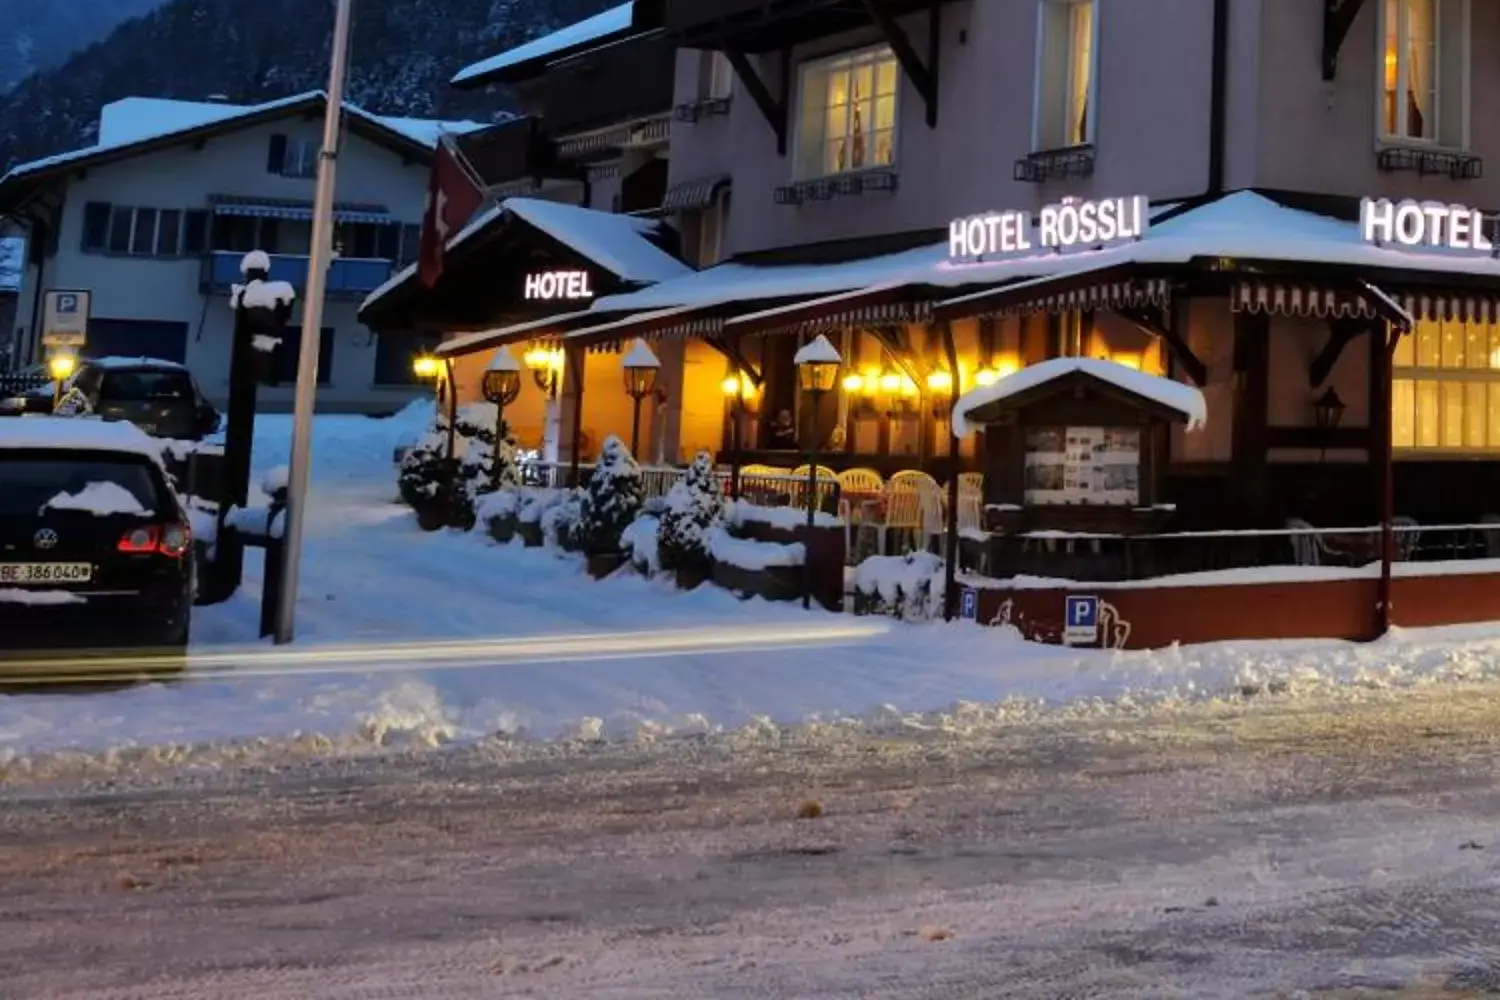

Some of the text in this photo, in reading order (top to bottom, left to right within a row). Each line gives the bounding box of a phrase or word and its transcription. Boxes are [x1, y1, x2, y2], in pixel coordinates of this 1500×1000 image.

[949, 195, 1143, 258] HOTEL RÖSSLI
[1365, 200, 1493, 251] HOTEL
[524, 271, 593, 300] HOTEL
[60, 296, 75, 310] P
[1075, 601, 1090, 624] P
